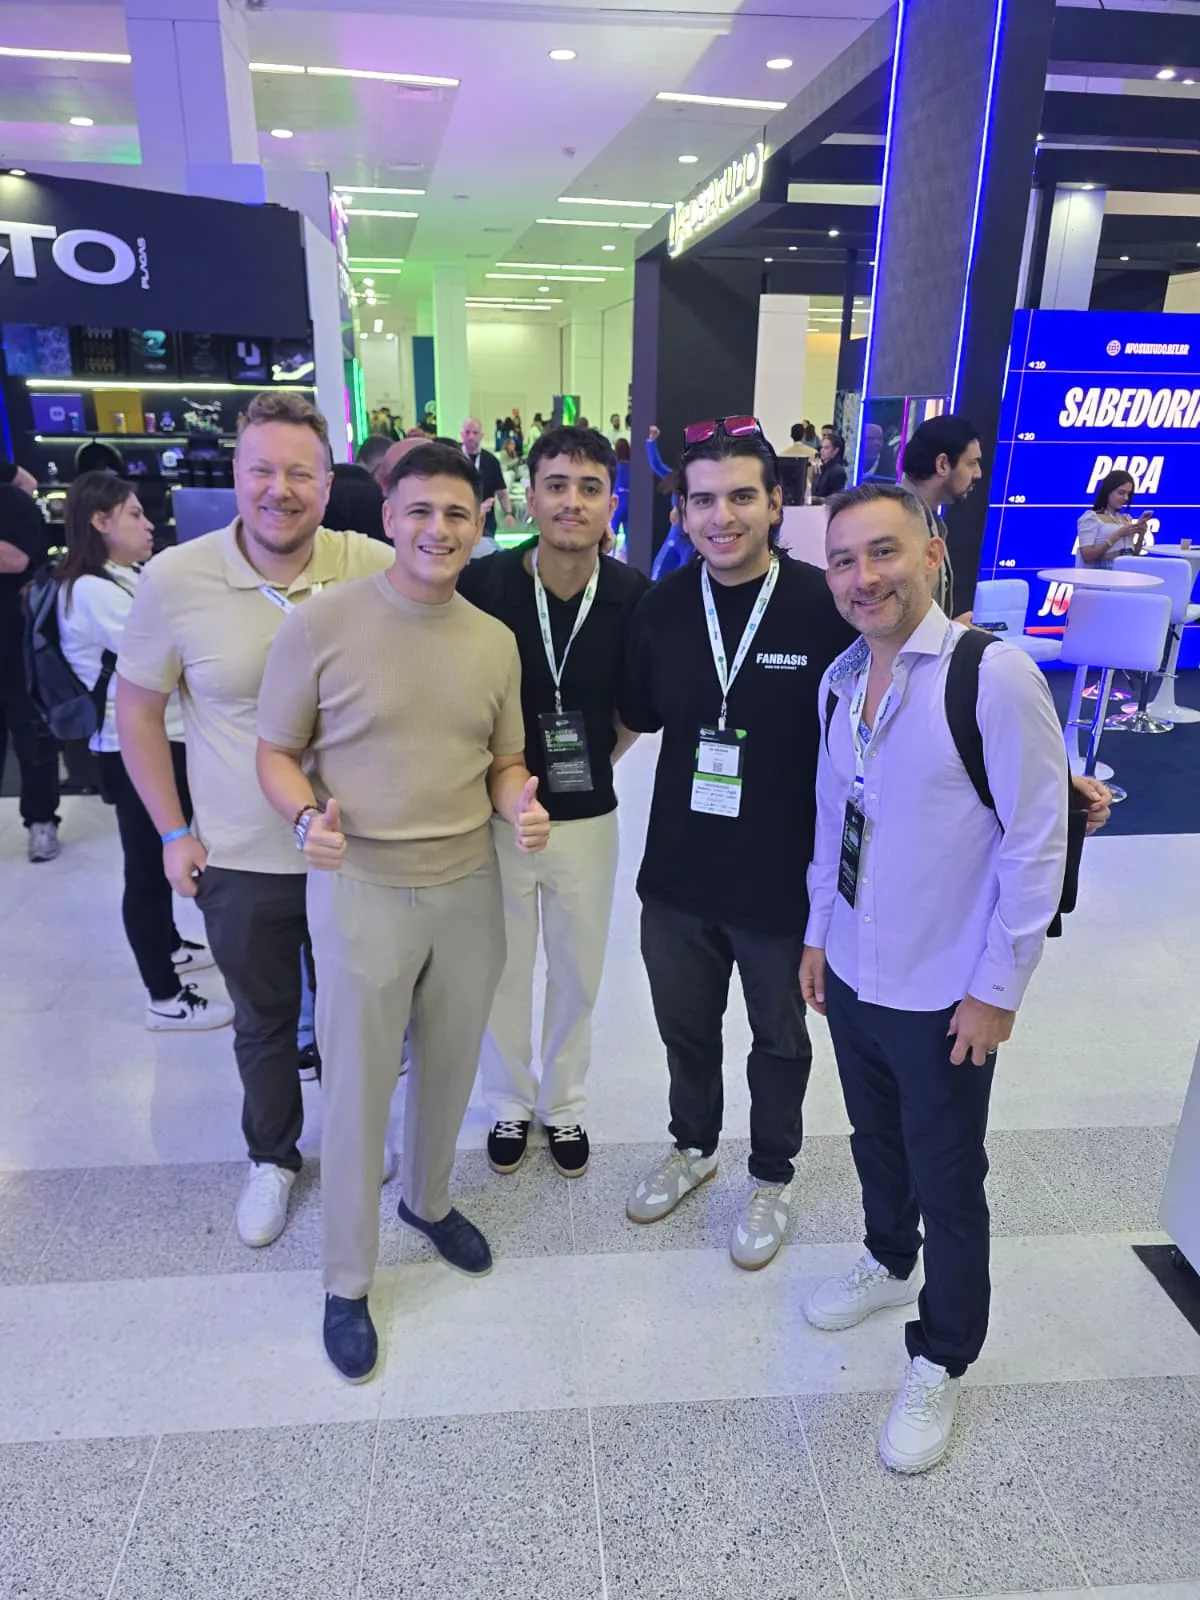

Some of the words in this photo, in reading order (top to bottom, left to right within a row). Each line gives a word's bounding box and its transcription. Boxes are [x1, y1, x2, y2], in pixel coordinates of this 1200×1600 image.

[0, 220, 136, 285] TO
[1034, 360, 1046, 369] 10
[1023, 432, 1035, 441] 20
[1004, 558, 1016, 567] 40
[1037, 581, 1074, 617] JO
[756, 652, 808, 667] FANBASIS
